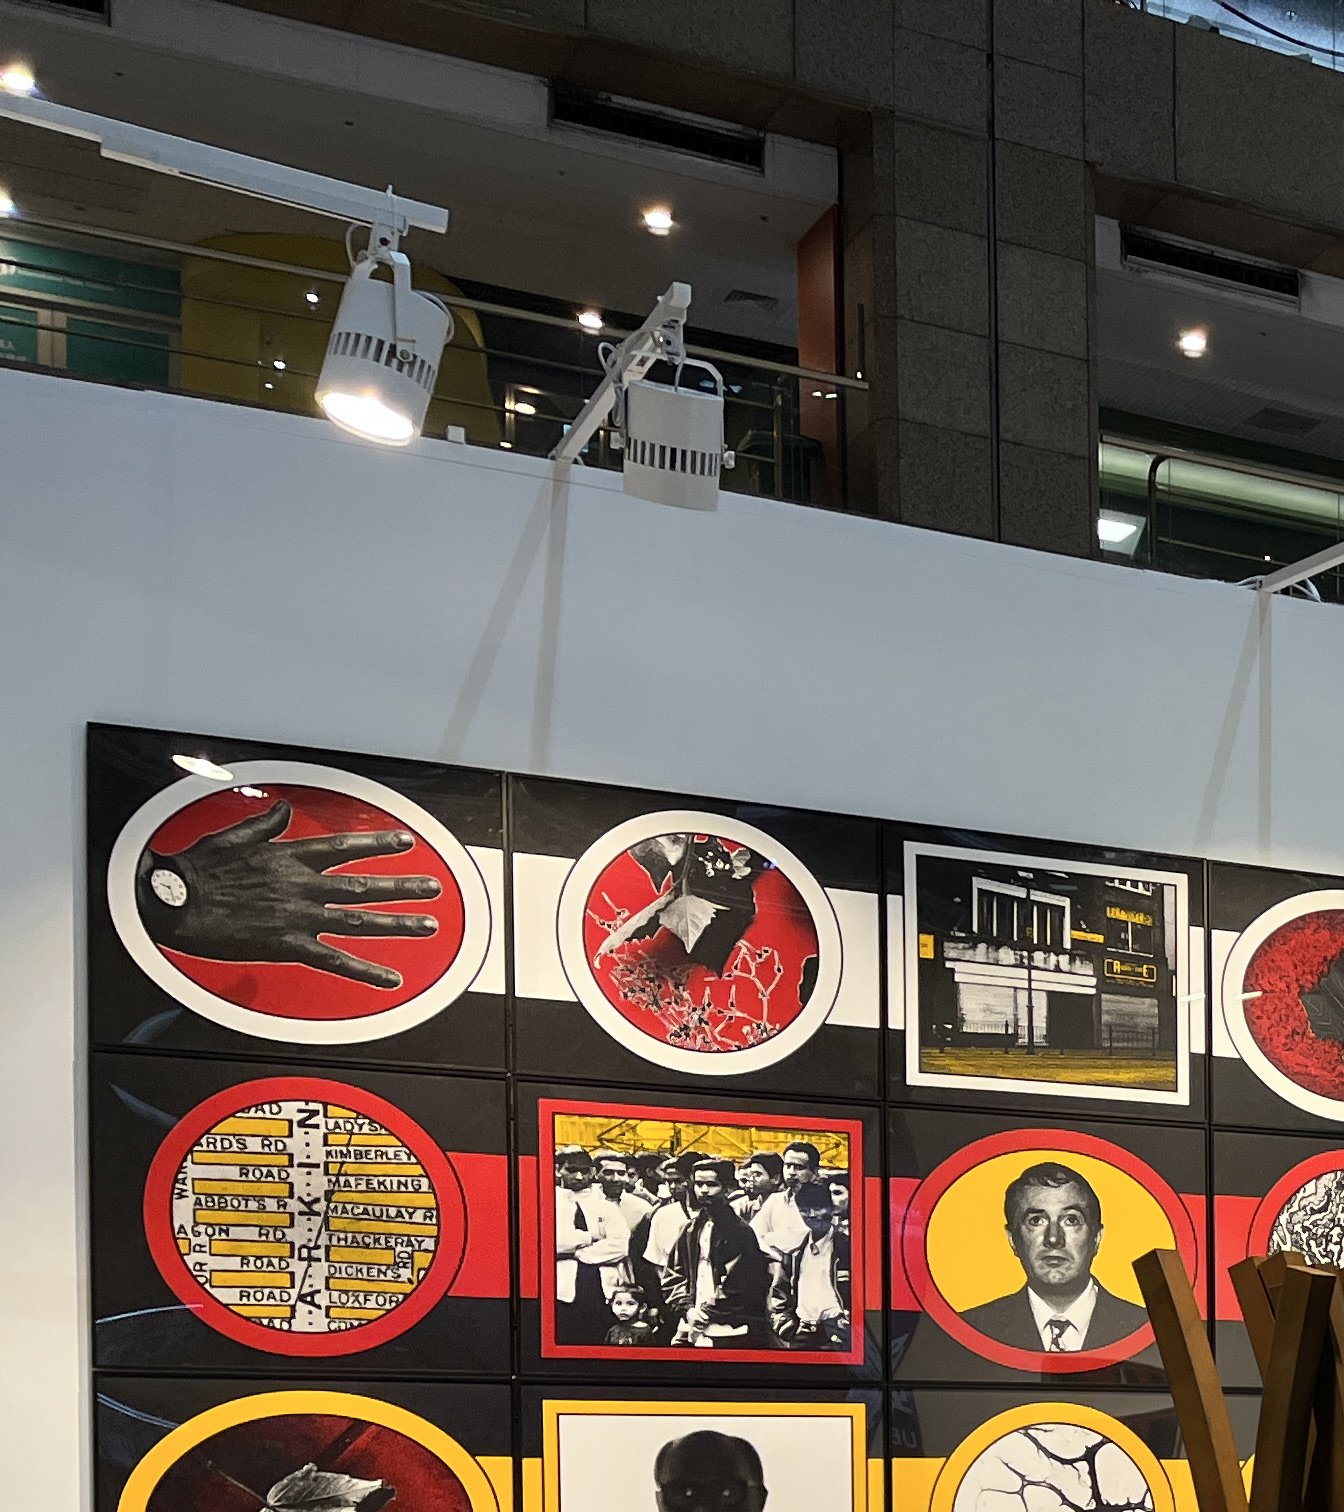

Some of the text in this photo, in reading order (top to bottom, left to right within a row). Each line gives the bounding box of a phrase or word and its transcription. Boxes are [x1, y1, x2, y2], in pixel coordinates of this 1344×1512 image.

[261, 1138, 287, 1152] RD
[325, 1148, 414, 1162] KIMBERLEY
[239, 1167, 290, 1181] ROAD
[327, 1177, 423, 1190] MAFEKING
[194, 1197, 267, 1211] ABBOT'S
[329, 1204, 415, 1220] MACAULAY
[326, 1234, 425, 1250] THACKERAY
[240, 1257, 290, 1270] ROAD
[239, 1290, 291, 1302] ROAD
